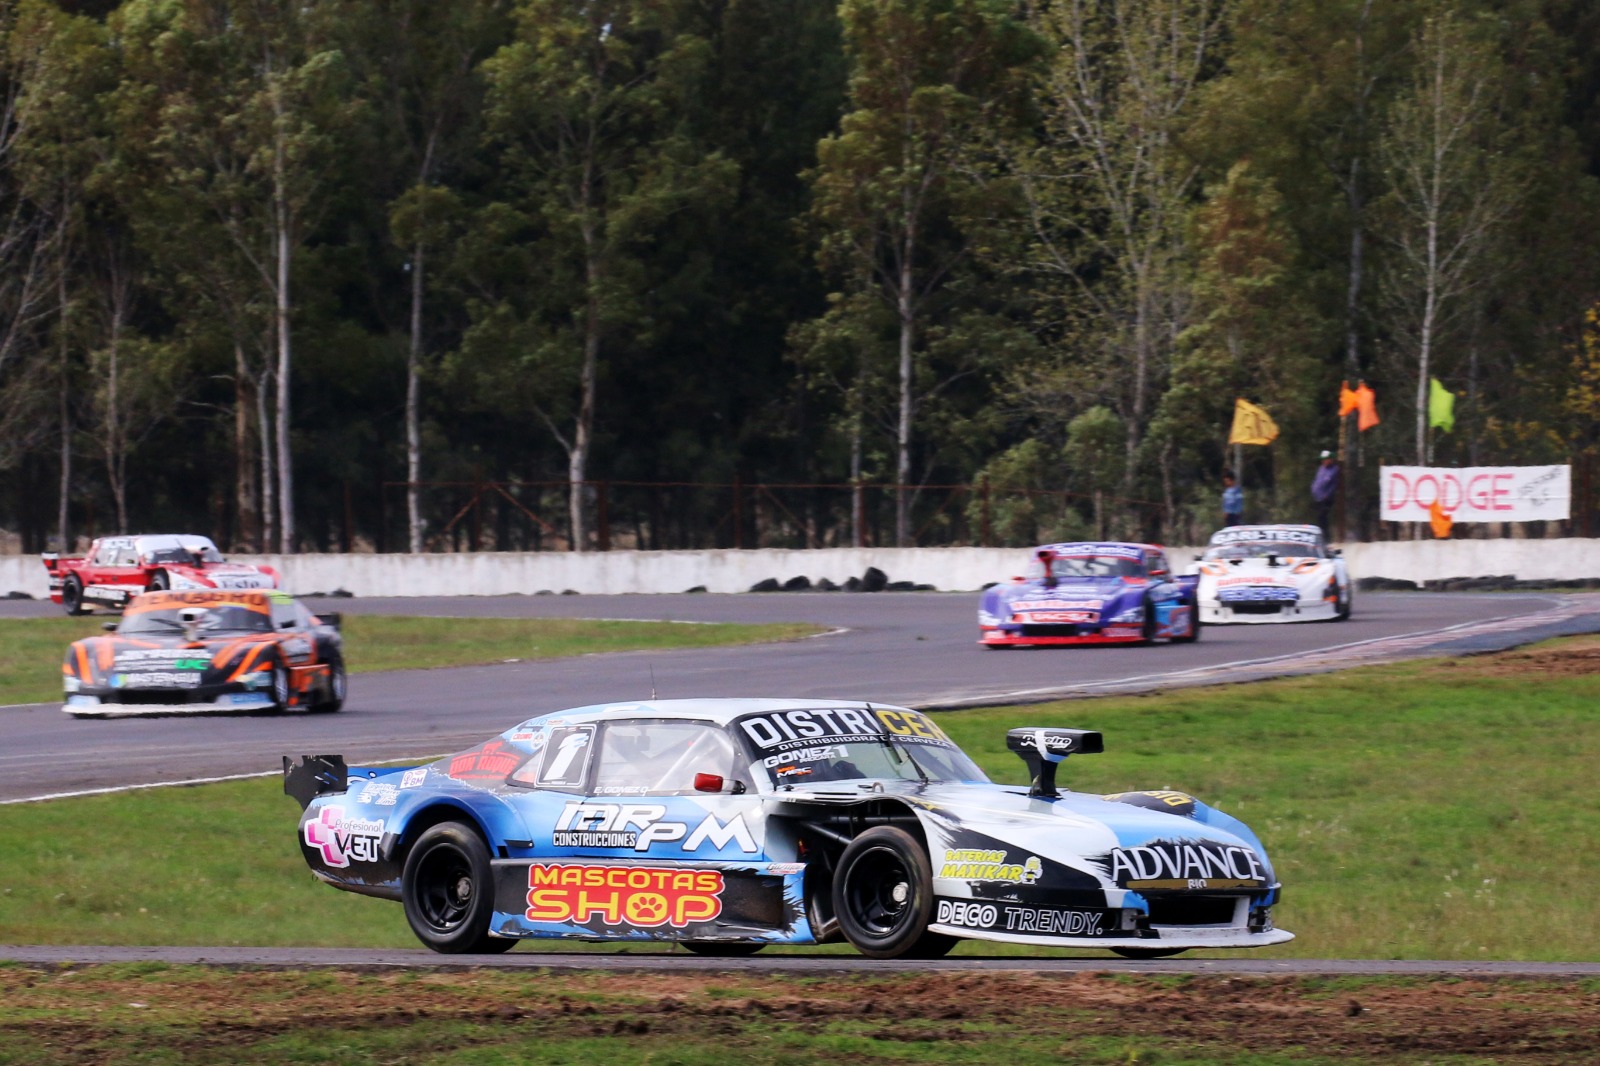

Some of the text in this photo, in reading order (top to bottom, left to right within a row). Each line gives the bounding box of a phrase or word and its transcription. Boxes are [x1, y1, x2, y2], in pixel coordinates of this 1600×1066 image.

[1388, 473, 1514, 512] DODGE
[779, 735, 879, 751] DISTRIBUIDORA
[476, 756, 519, 776] ROQUE
[542, 732, 590, 781] 1
[764, 745, 849, 768] GOMEZ 1
[604, 786, 640, 794] GOMEZ
[335, 819, 382, 834] Profesional
[334, 833, 380, 859] VET
[553, 832, 636, 848] CONSTRUCCIONES
[944, 849, 1006, 864] BATERIAS
[1112, 845, 1265, 881] ADVANCE
[534, 867, 718, 892] MASCOTAS
[941, 863, 1023, 882] MAXIKAR
[530, 889, 716, 924] SHOP
[936, 900, 998, 928] DECO
